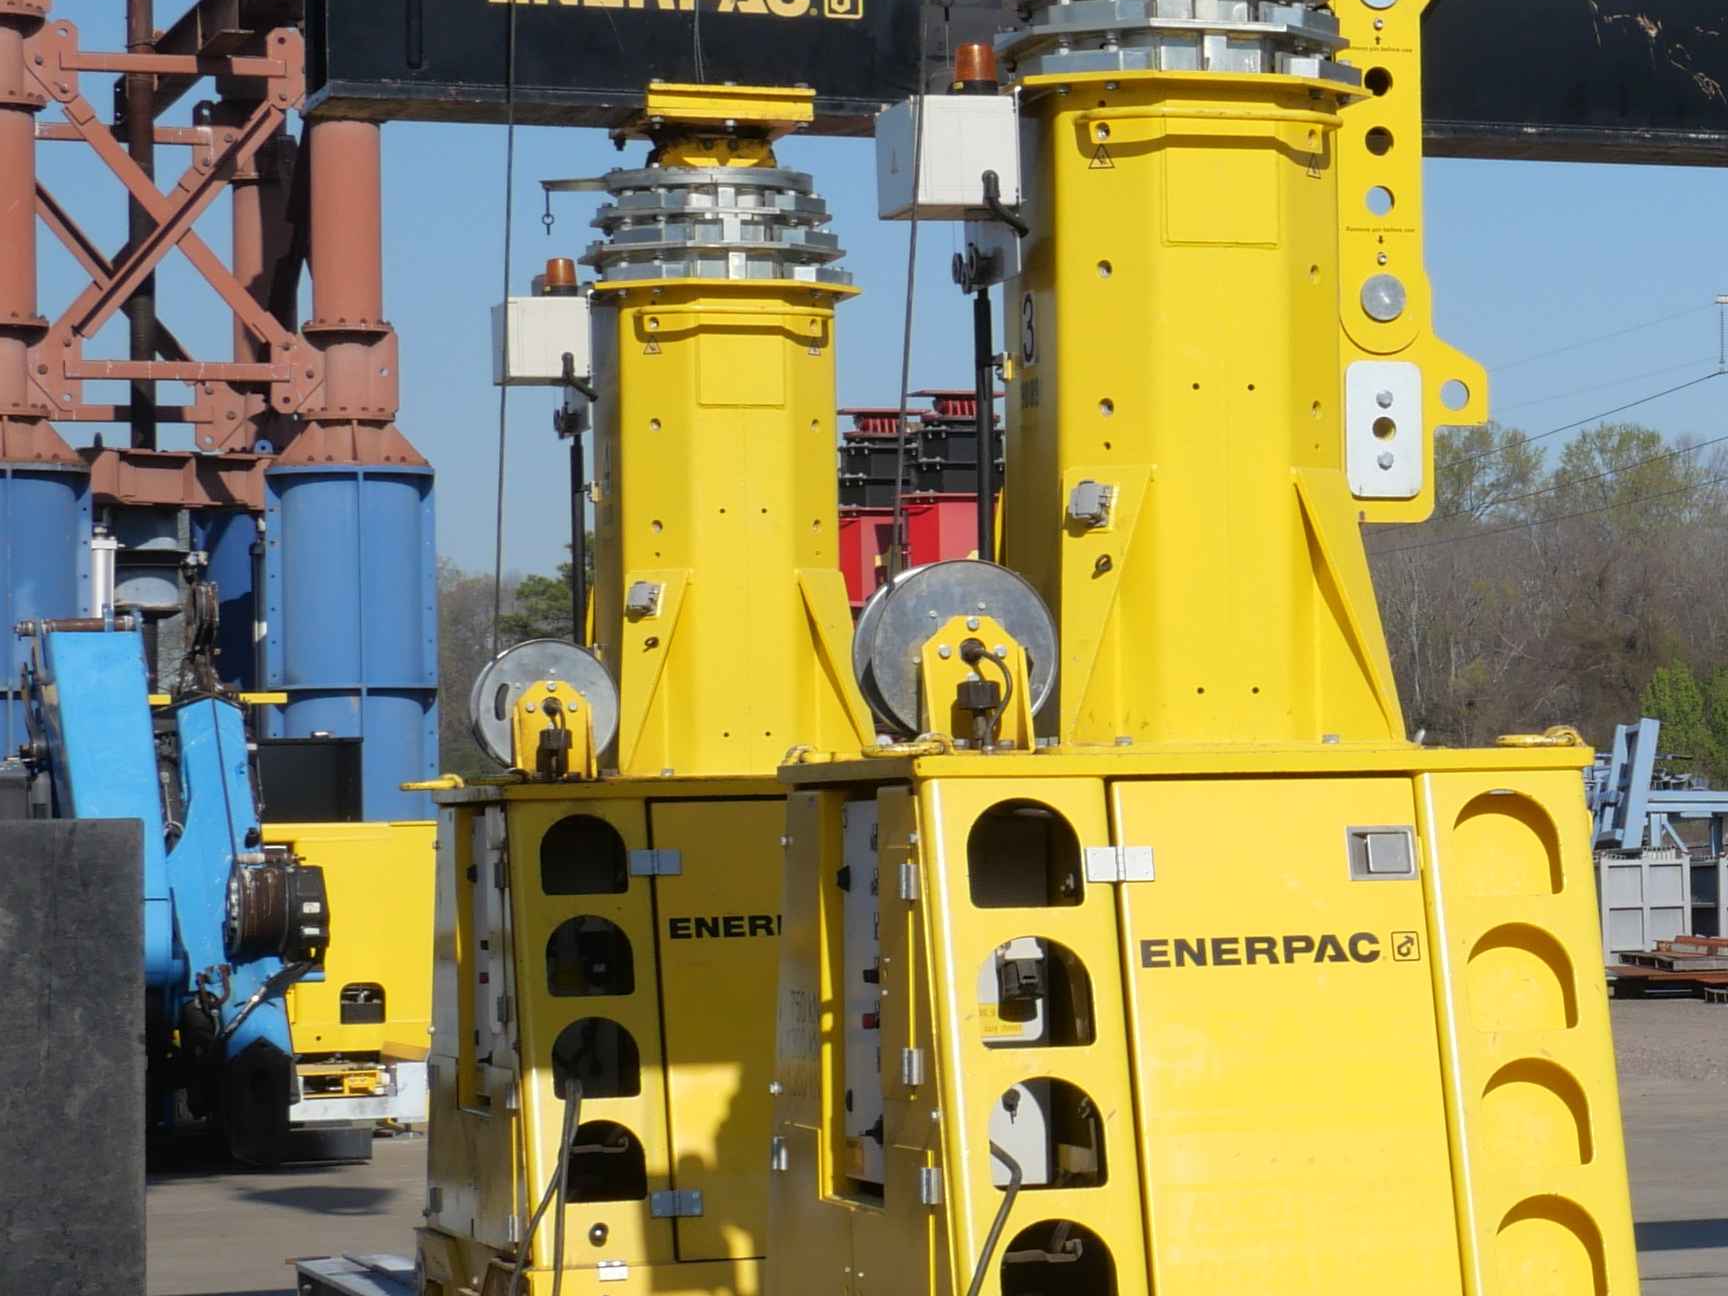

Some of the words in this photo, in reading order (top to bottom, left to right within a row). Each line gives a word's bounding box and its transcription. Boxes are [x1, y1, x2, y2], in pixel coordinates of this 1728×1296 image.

[1023, 293, 1034, 363] 3
[669, 913, 782, 940] ENER
[1141, 934, 1380, 968] ENERPAC
